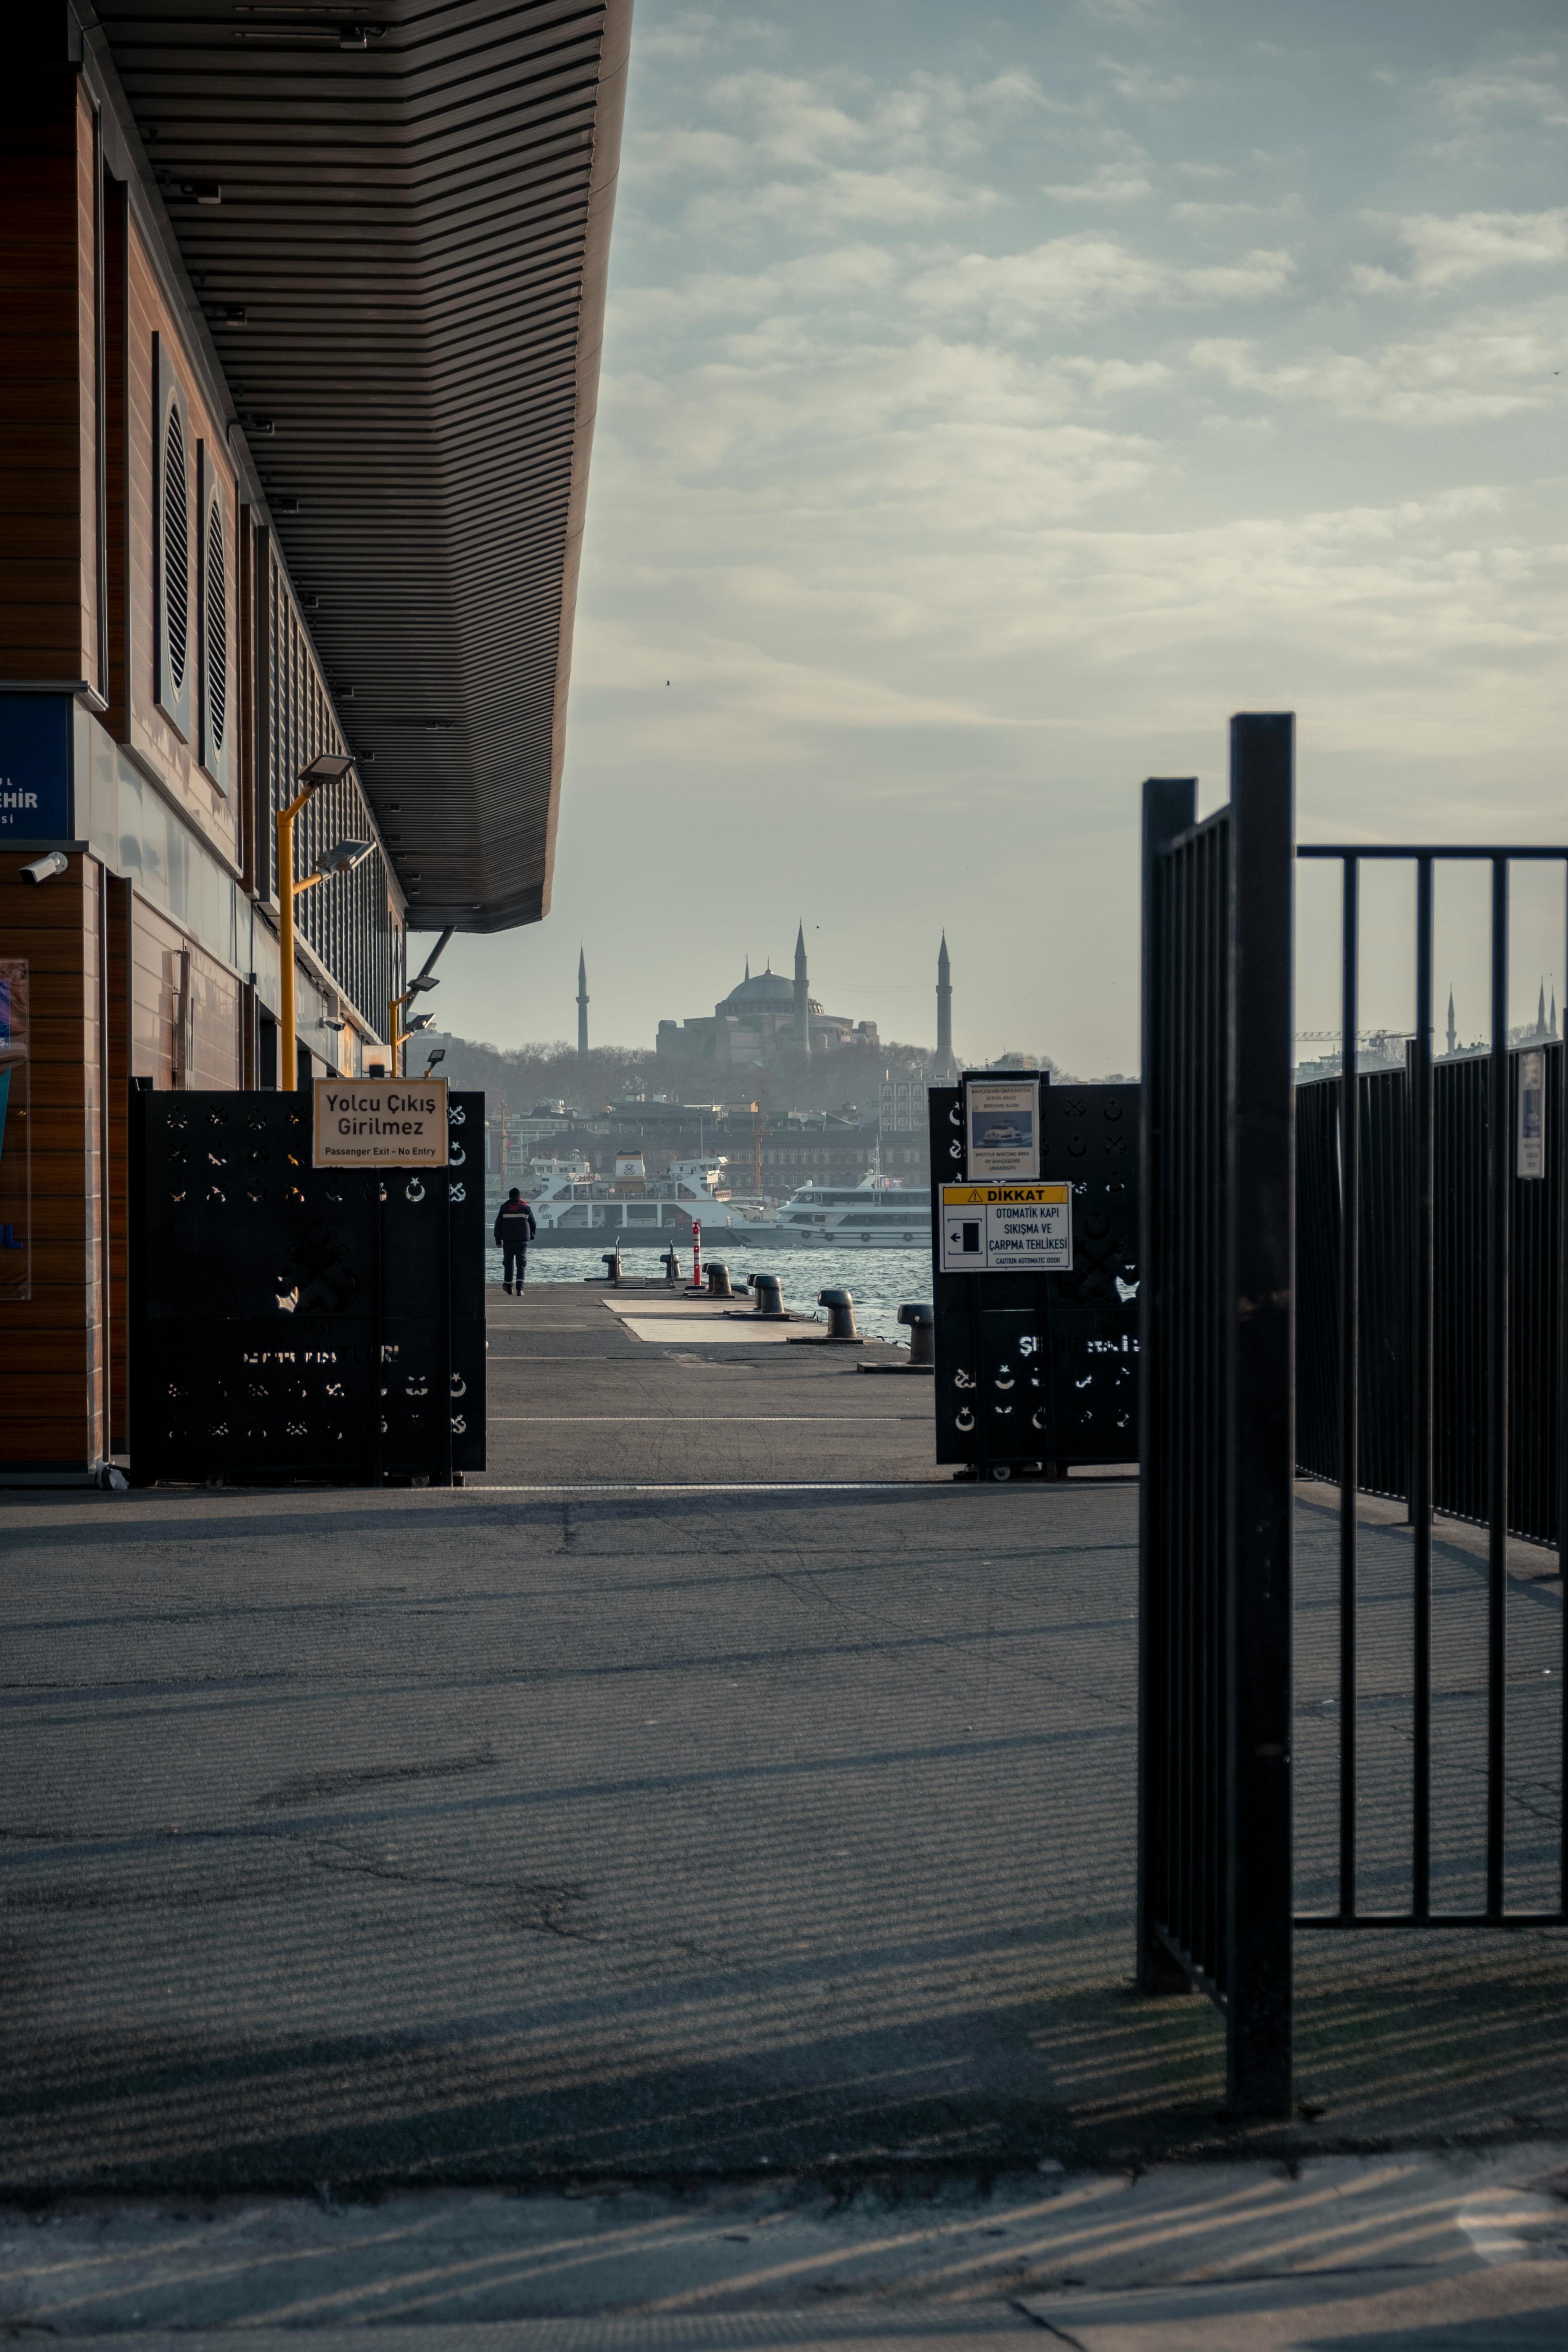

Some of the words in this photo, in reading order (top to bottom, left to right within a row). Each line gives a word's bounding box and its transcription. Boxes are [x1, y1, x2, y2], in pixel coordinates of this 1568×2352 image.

[325, 1094, 380, 1111] Yolcu
[387, 1094, 435, 1114] Çıkış
[338, 1118, 423, 1134] Girilmez
[325, 1147, 371, 1157] Passenger
[413, 1147, 435, 1157] Entry
[988, 1188, 1045, 1201] DİKKAT
[997, 1206, 1037, 1218] OTOMATİK
[1040, 1208, 1059, 1218] KAPI
[1004, 1224, 1039, 1235] SIKIŞMA
[1041, 1223, 1052, 1234] VE
[989, 1240, 1024, 1251] ÇARPMA
[1026, 1237, 1067, 1250] TEHLİKESİ
